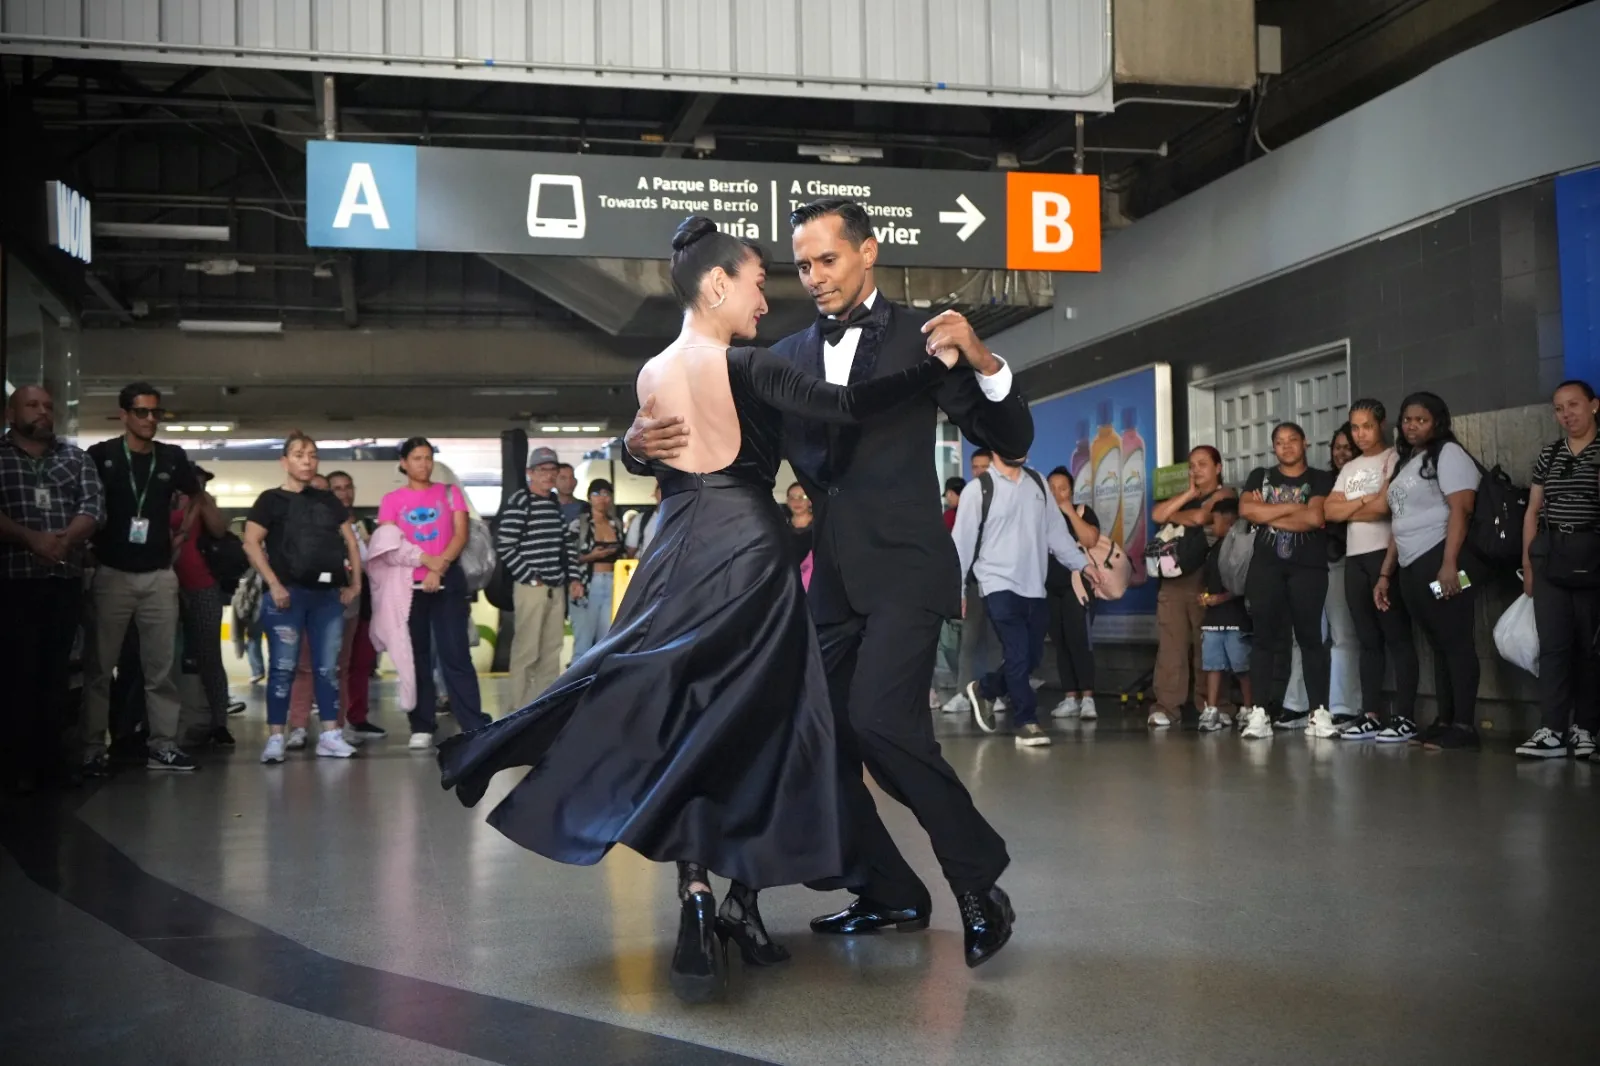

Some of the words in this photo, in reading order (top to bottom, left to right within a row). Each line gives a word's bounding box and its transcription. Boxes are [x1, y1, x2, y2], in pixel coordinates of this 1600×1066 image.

[637, 176, 649, 190] A
[653, 177, 705, 194] Parque
[708, 178, 759, 194] Berrío
[790, 179, 802, 194] A
[806, 180, 871, 197] Cisneros
[332, 162, 391, 230] A
[597, 195, 659, 209] Towards
[661, 196, 709, 212] Parque
[713, 198, 759, 213] Berrío
[857, 201, 913, 217] isneros
[1031, 190, 1074, 253] B
[873, 221, 921, 245] vier
